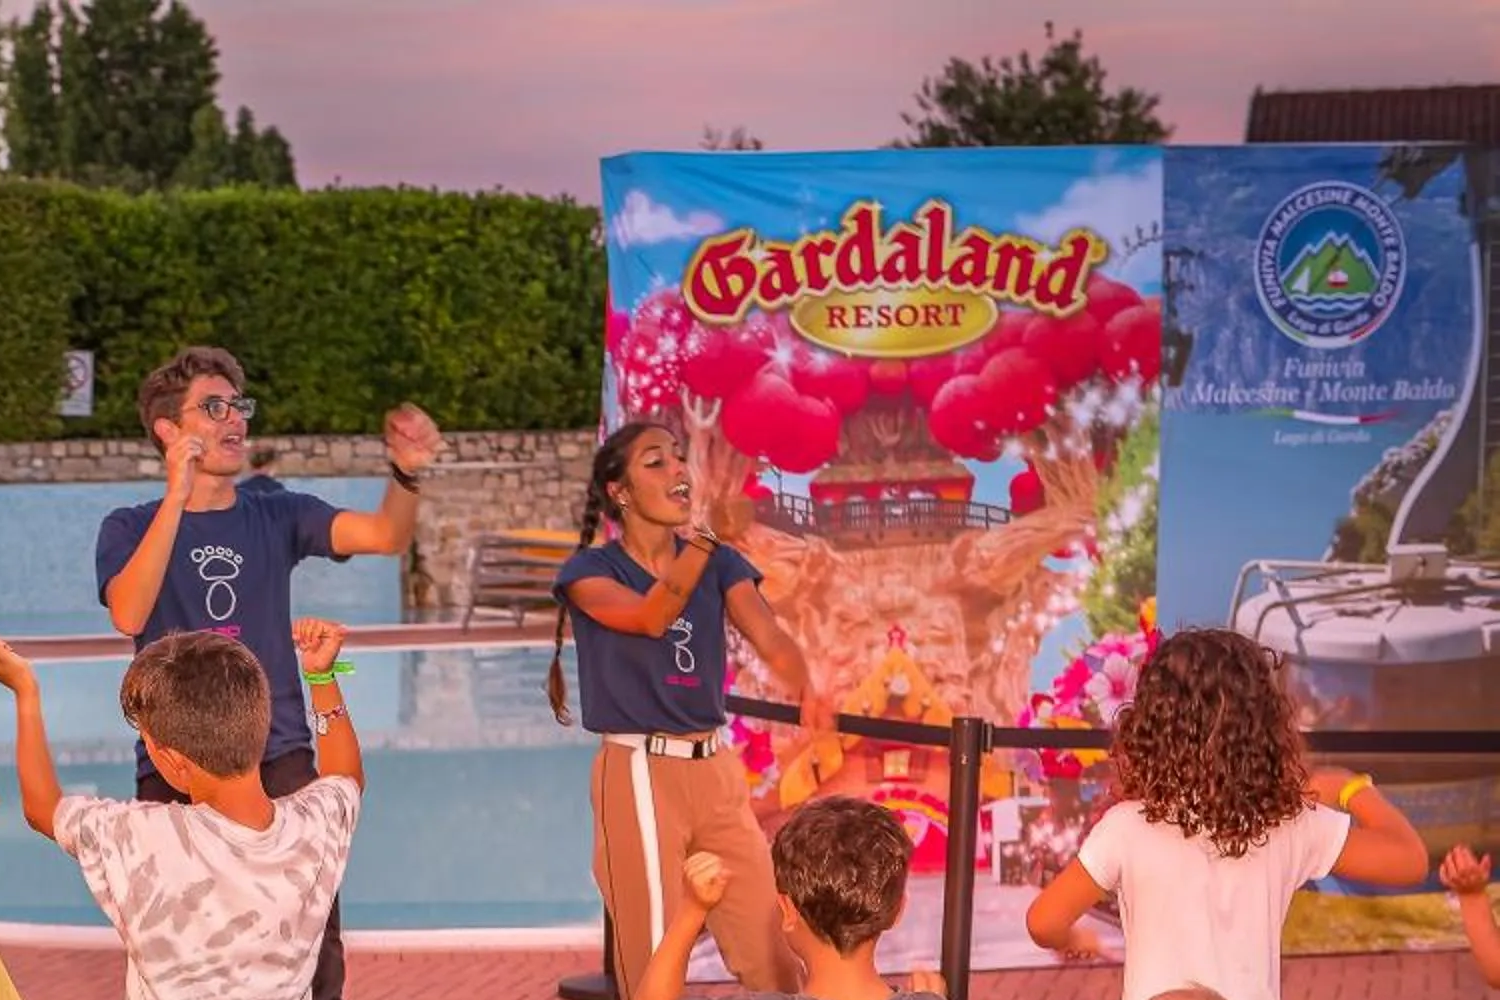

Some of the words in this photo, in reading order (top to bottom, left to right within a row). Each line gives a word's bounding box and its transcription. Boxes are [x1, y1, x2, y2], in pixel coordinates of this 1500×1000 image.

[1271, 188, 1353, 236] MALCESINE
[1354, 192, 1398, 244] MONTE
[688, 203, 1094, 318] Gardaland
[825, 302, 967, 331] RESORT
[1283, 358, 1366, 379] Funivia
[1190, 380, 1301, 405] Malcesine
[1318, 379, 1388, 403] Monte
[1392, 376, 1456, 401] Baldo
